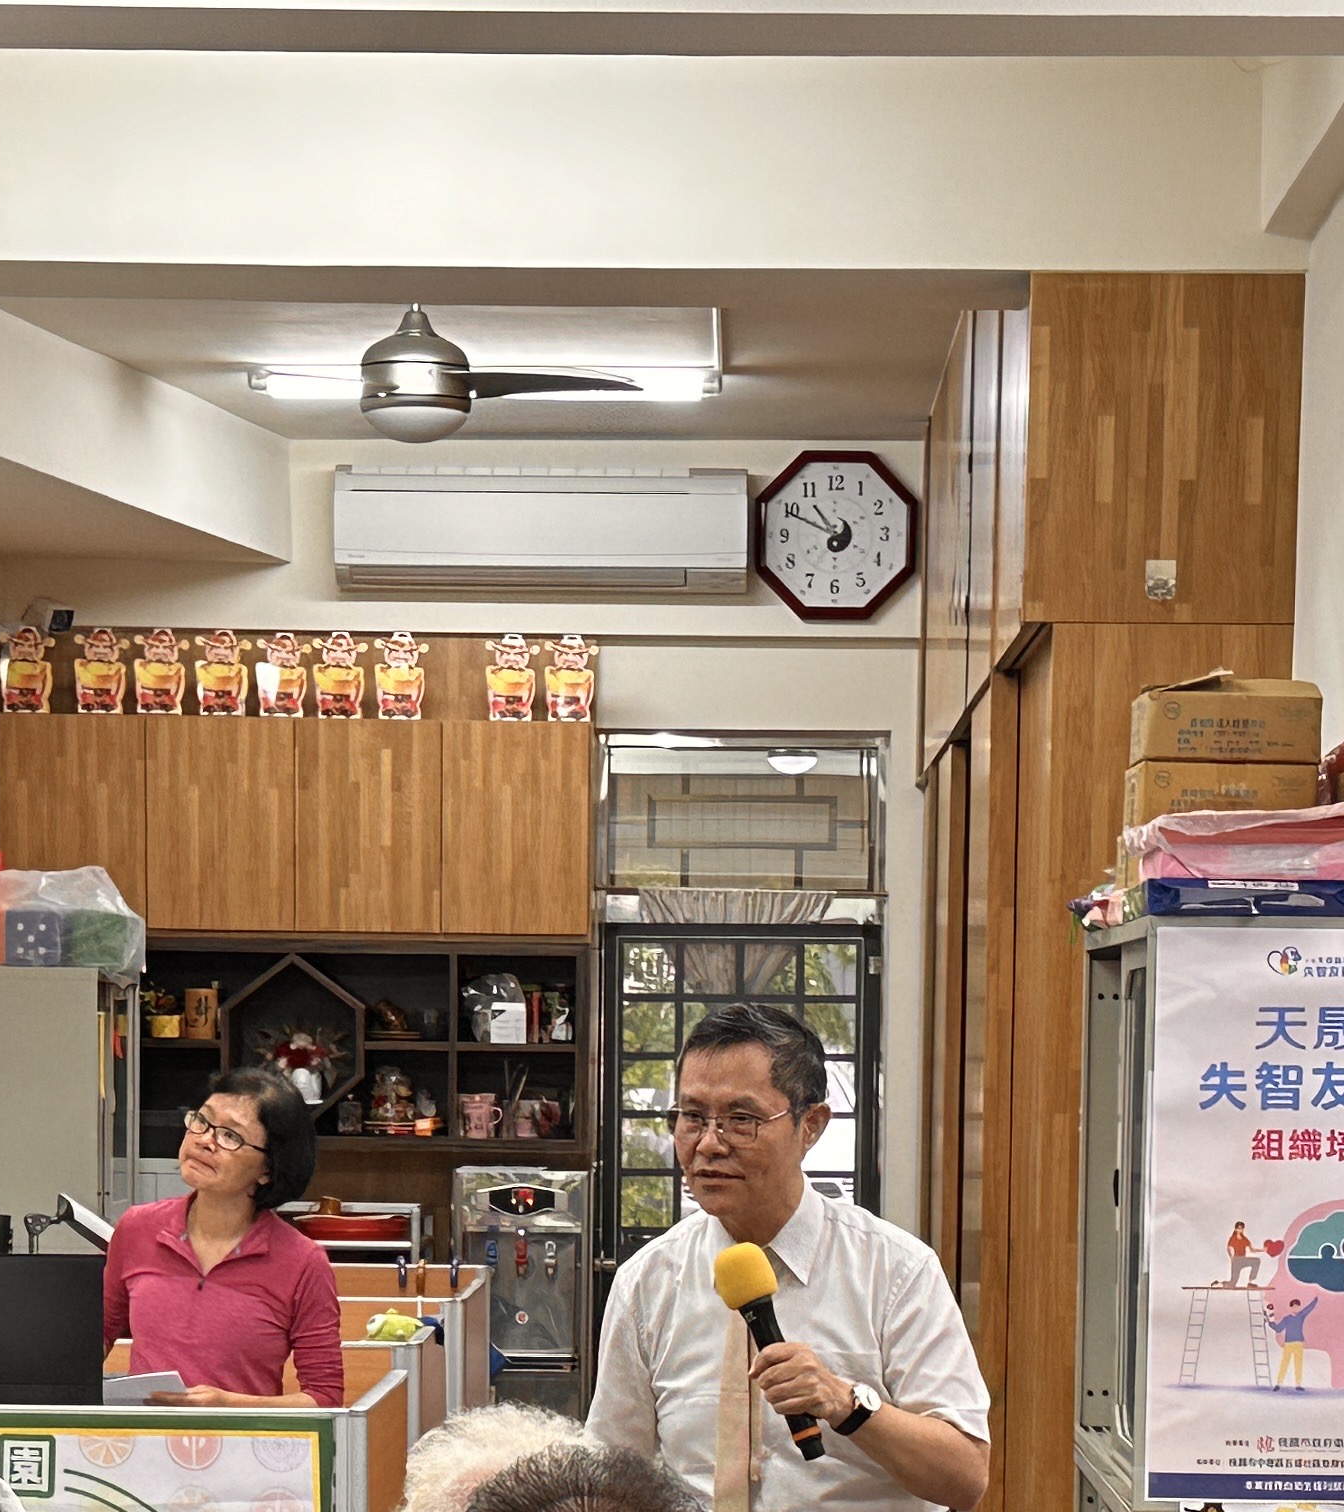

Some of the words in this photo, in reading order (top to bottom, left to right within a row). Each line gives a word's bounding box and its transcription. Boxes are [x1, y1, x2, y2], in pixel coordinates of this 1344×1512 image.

[802, 482, 816, 498] 11
[828, 475, 845, 491] 12
[857, 481, 864, 496] 1
[784, 502, 800, 518] 10
[874, 500, 884, 515] 2
[780, 528, 789, 543] 9
[879, 526, 890, 542] 3
[785, 553, 796, 569] 8
[873, 551, 881, 567] 4
[805, 573, 815, 588] 7
[830, 579, 840, 594] 6
[856, 572, 866, 587] 5
